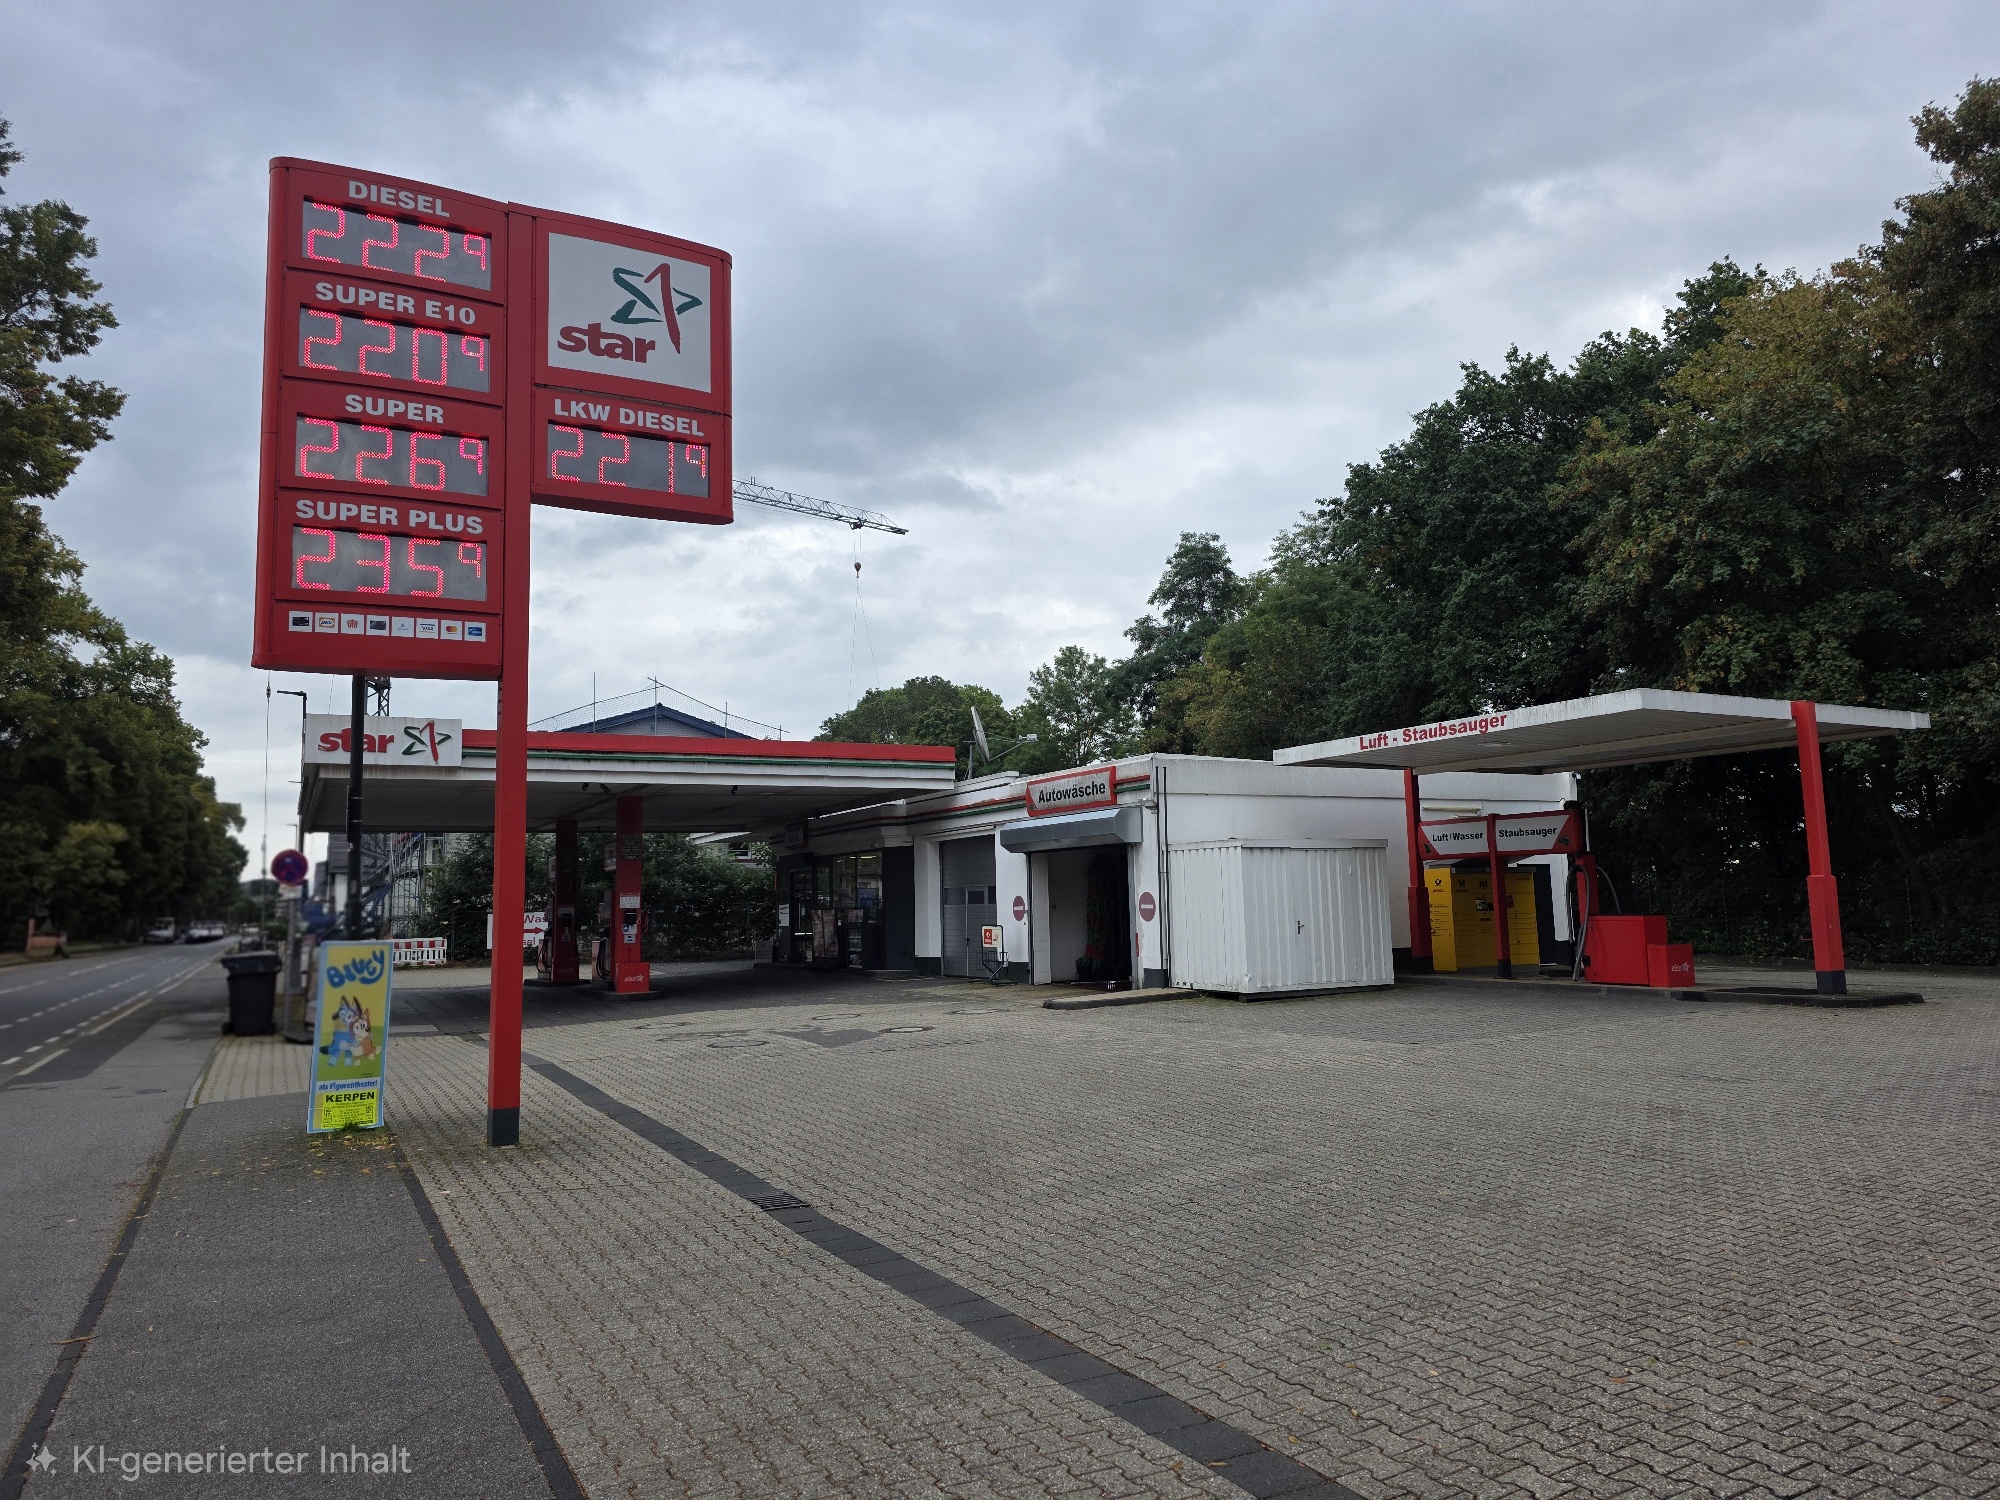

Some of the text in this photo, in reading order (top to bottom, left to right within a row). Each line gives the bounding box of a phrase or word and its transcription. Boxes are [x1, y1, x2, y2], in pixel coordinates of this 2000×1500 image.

[348, 180, 450, 218] DIESEL
[315, 282, 476, 325] SUPER E10
[557, 322, 656, 363] star
[345, 394, 444, 424] SUPER
[554, 398, 705, 437] LKW DIESEL
[295, 499, 484, 535] SUPER PLUS
[1359, 732, 1388, 751] Luft
[1402, 714, 1508, 743] Staubsauger
[1038, 780, 1106, 804] Autowäsche
[1498, 827, 1558, 838] Staubsauger
[319, 1080, 378, 1091] als Figurentheater!
[325, 1091, 374, 1102] KERPEN
